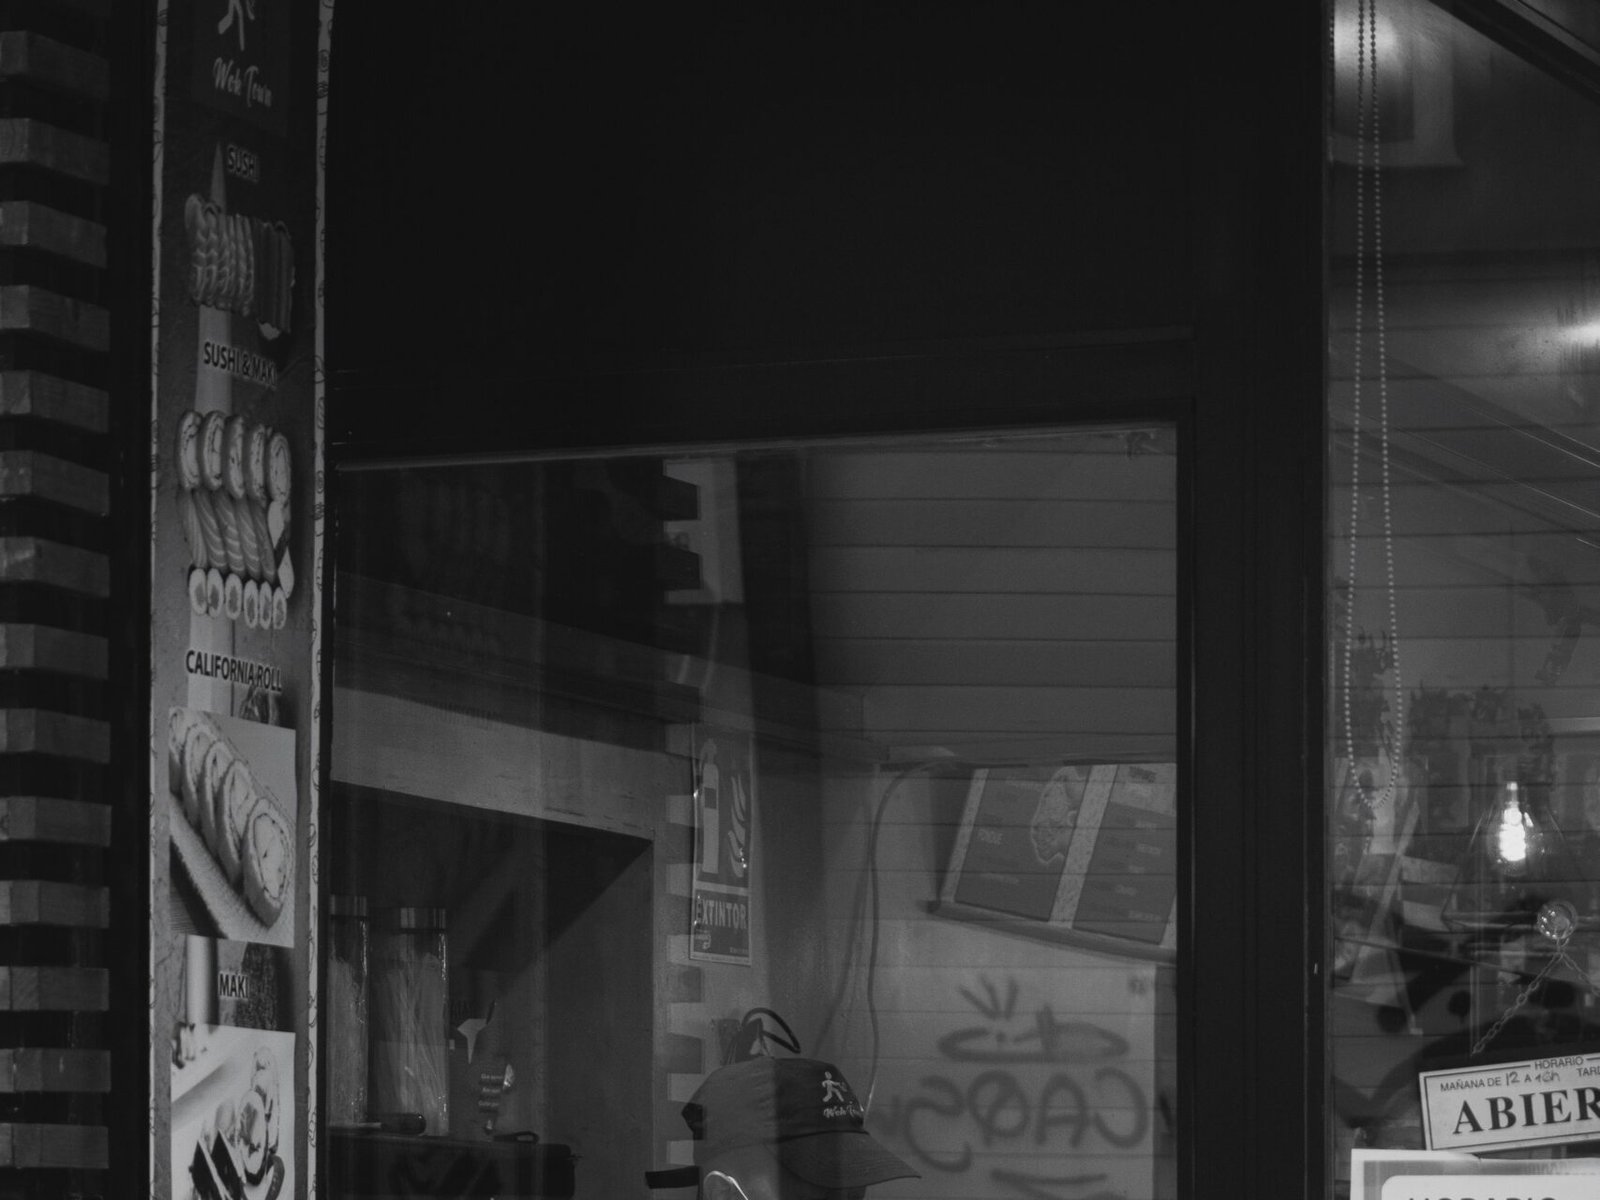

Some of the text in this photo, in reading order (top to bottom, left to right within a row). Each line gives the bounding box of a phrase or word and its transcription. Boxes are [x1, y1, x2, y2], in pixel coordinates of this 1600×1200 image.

[203, 341, 240, 374] SUSHI
[242, 352, 251, 377] &
[186, 650, 283, 692] CALIFORNIA ROLL
[219, 973, 249, 999] MAKI
[1534, 1055, 1584, 1070] HORARIO
[1440, 1077, 1485, 1092] MAÑANA
[1487, 1076, 1501, 1087] DE
[1505, 1070, 1521, 1086] 12
[1524, 1073, 1532, 1083] A
[1452, 1086, 1600, 1135] ABIER
